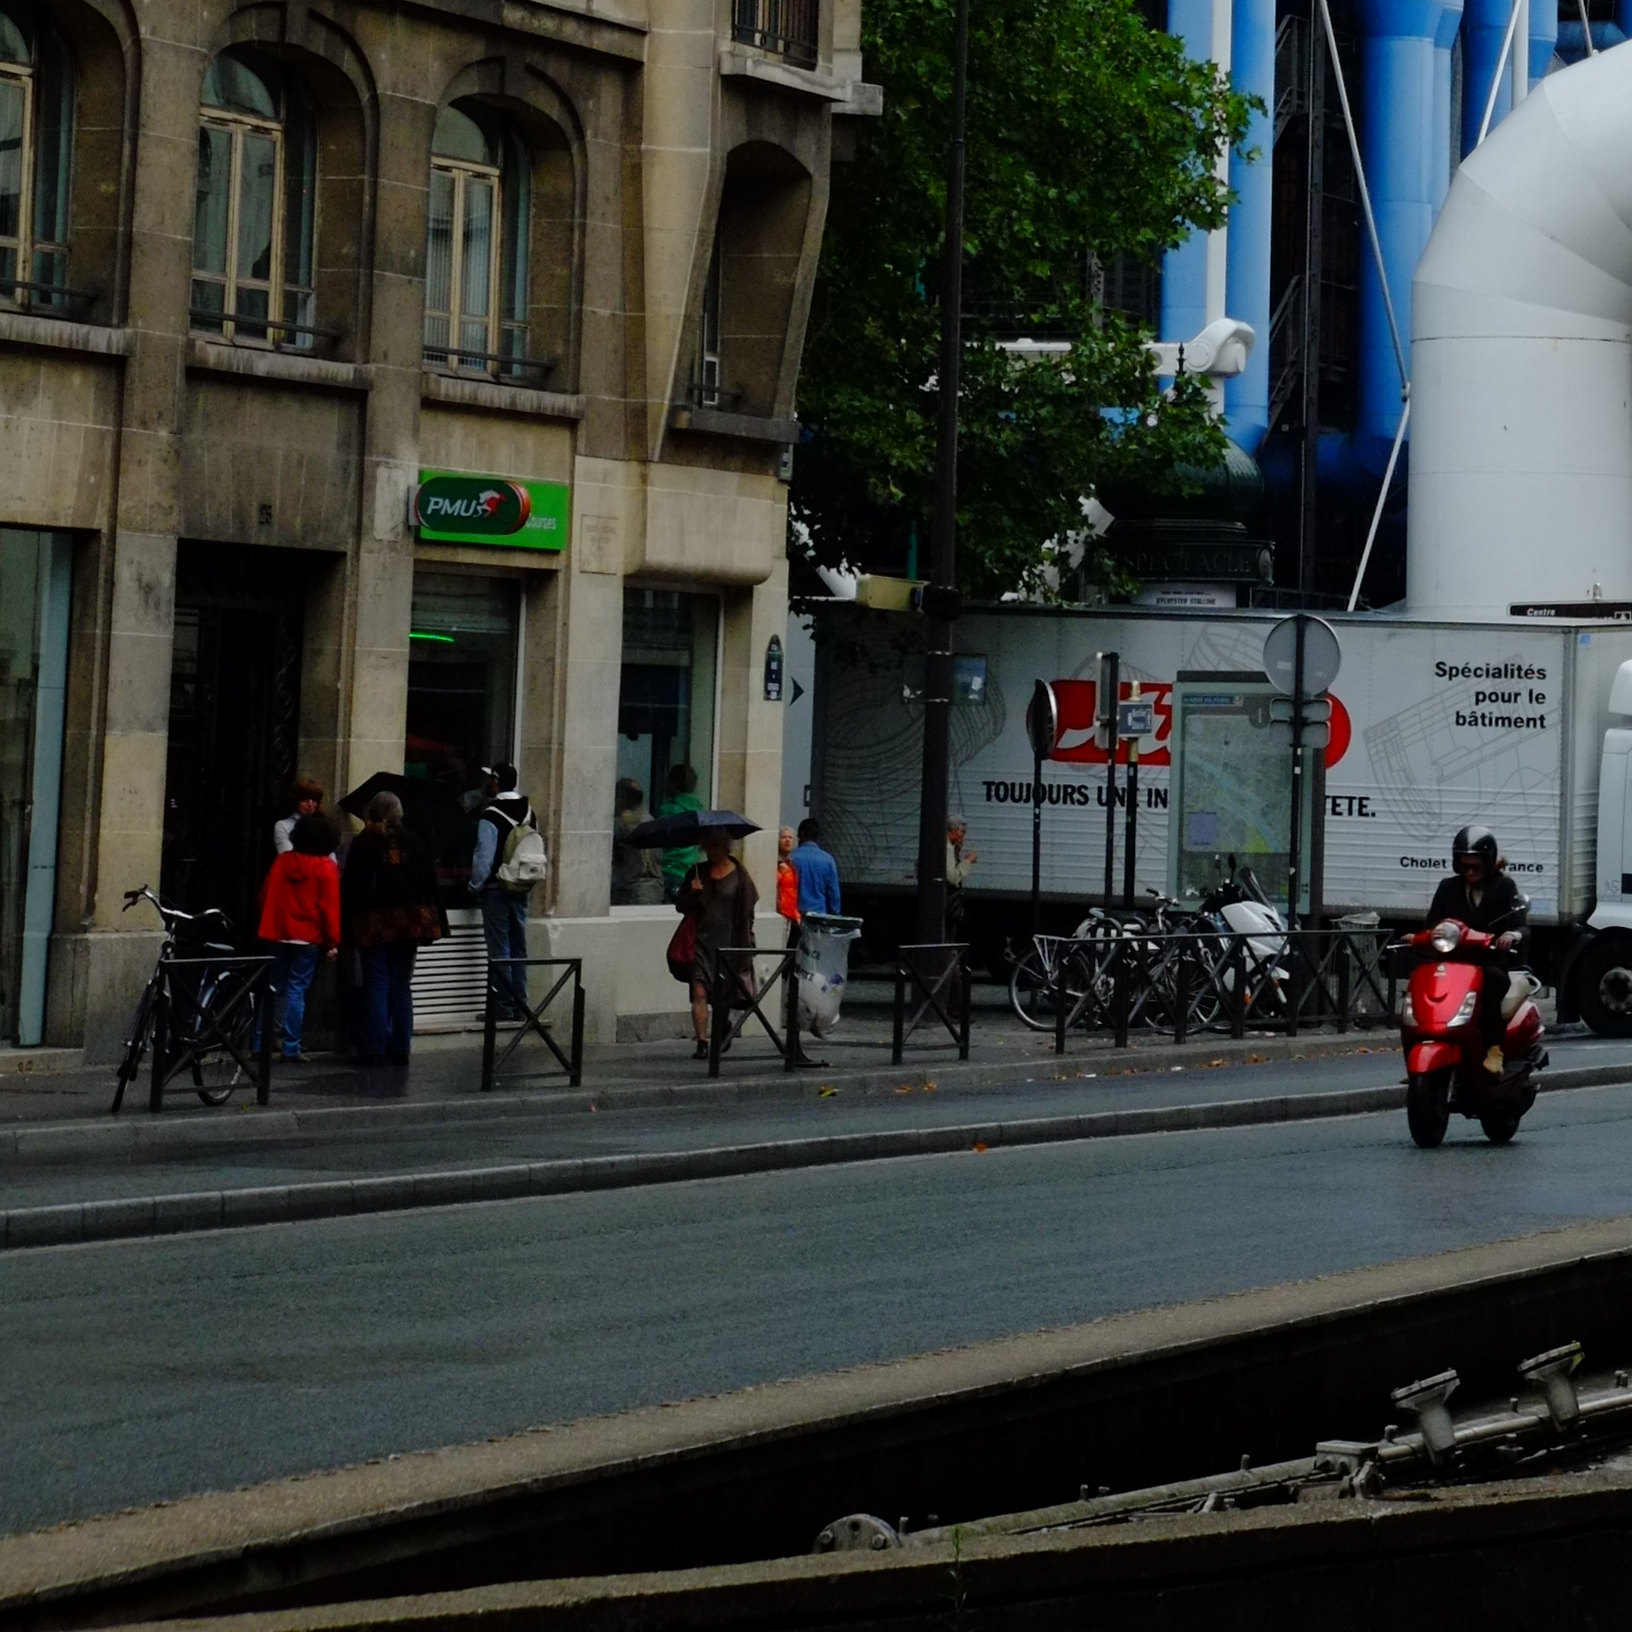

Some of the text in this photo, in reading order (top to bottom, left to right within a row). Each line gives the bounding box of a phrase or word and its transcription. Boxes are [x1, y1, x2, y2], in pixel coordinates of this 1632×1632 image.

[426, 497, 477, 517] PMU
[1435, 661, 1547, 680] Spécialités
[1475, 689, 1546, 706] pour le
[1455, 711, 1546, 728] bâtiment
[982, 779, 1090, 806] TOUJOURS
[1097, 785, 1139, 807] UN
[1399, 856, 1447, 870] Cholet
